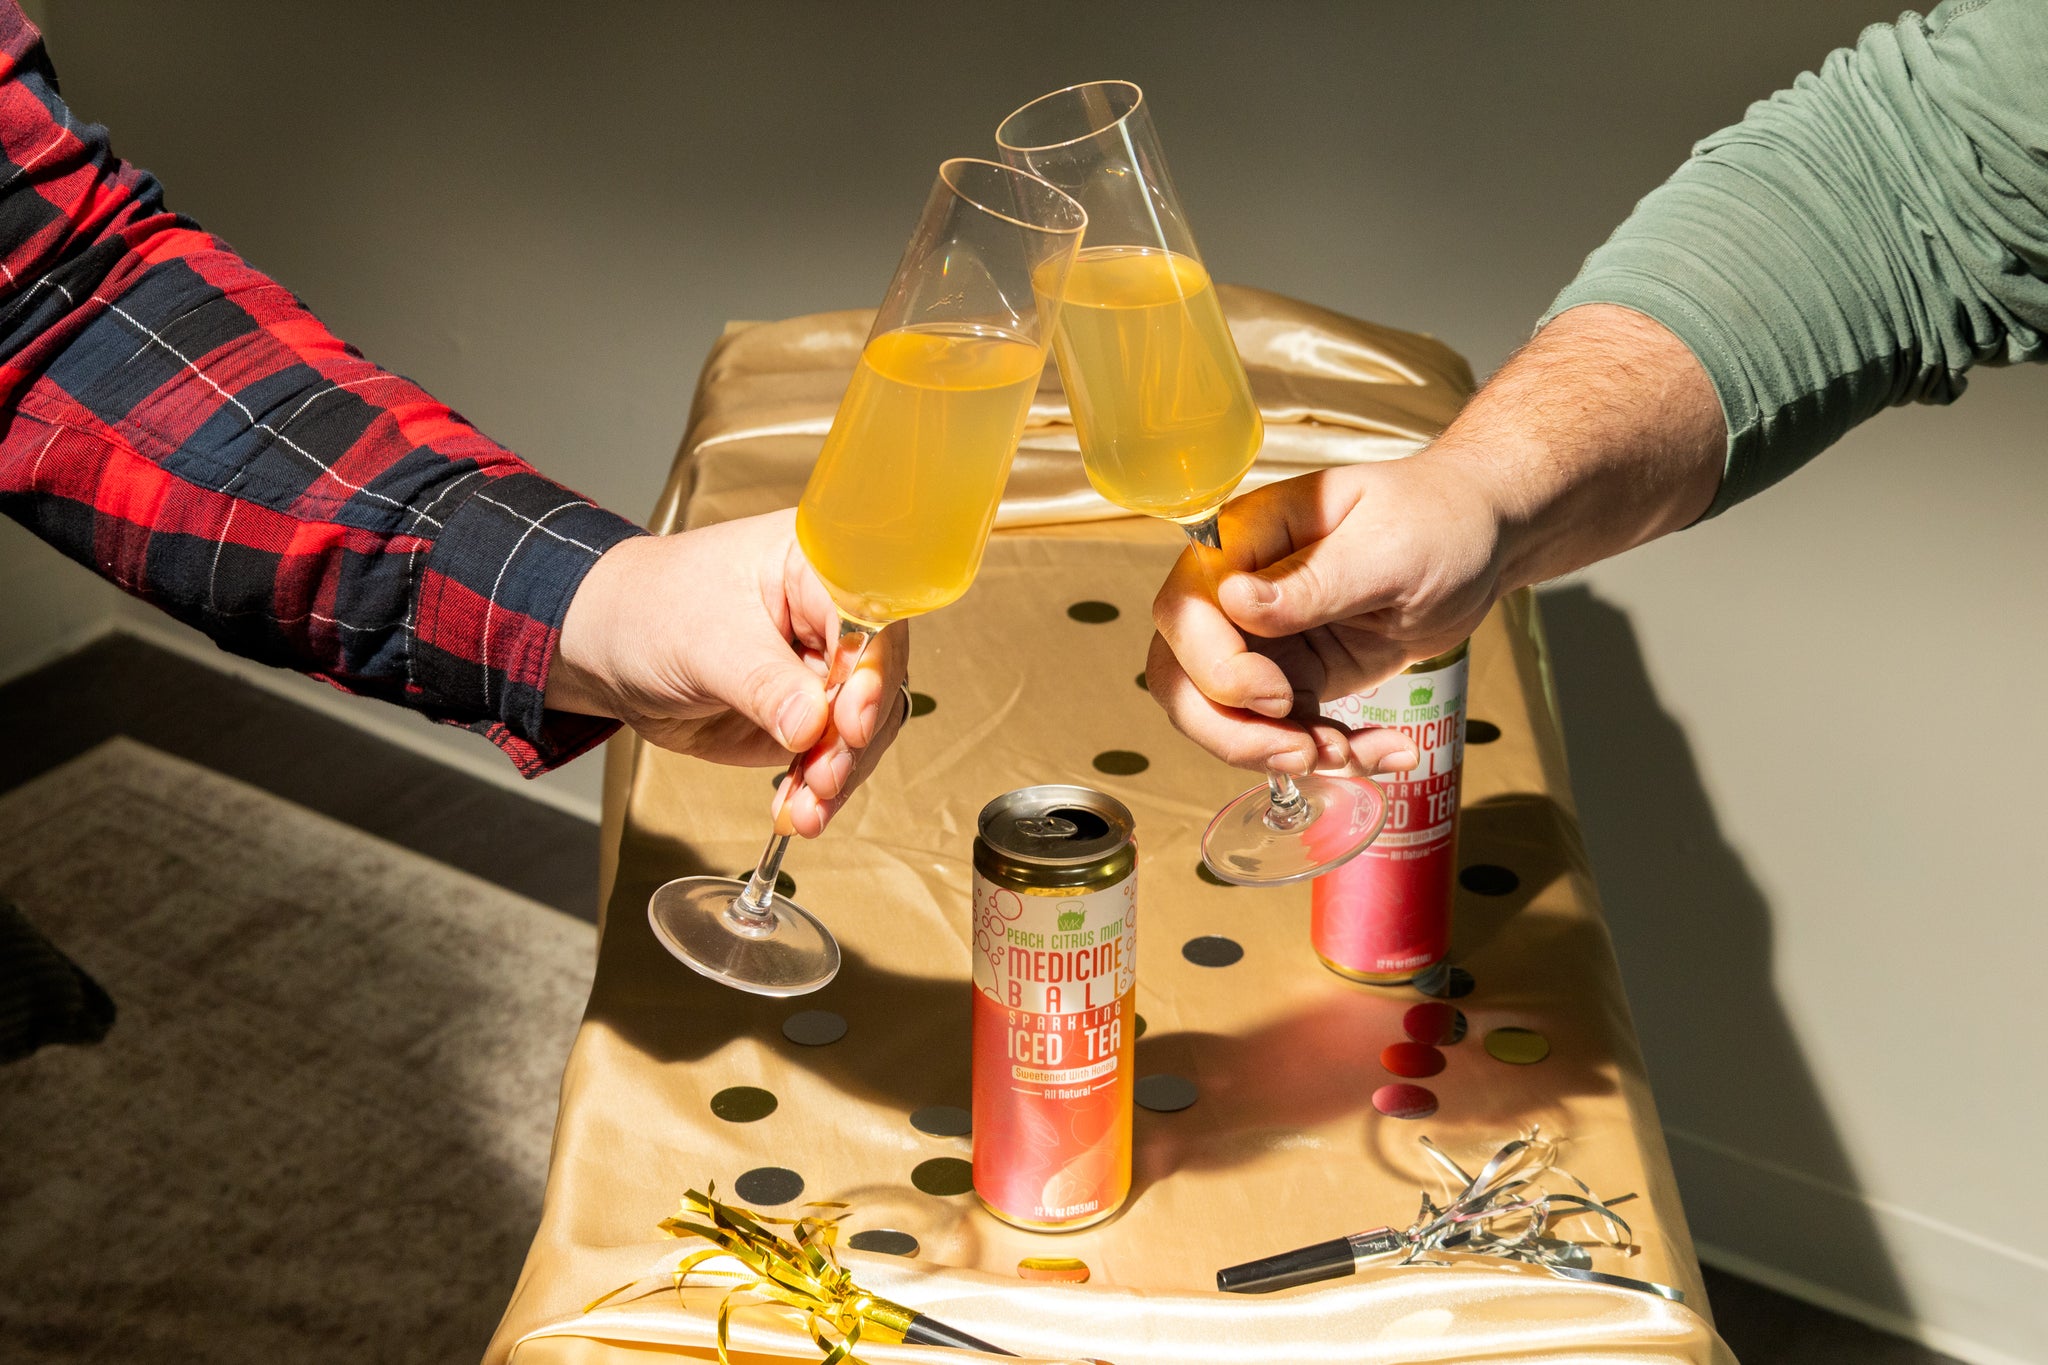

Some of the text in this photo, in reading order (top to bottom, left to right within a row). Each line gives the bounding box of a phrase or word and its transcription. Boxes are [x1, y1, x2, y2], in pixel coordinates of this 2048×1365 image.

[1362, 705, 1397, 723] PEACH
[1403, 704, 1440, 723] CITRUS
[1363, 710, 1460, 751] ICINE
[1386, 769, 1456, 798] ARKLING
[1427, 785, 1455, 824] TEA
[1007, 918, 1123, 949] PEACH CITRUS MINT
[1059, 919, 1080, 930] WK
[1008, 936, 1122, 983] MEDICINE
[1008, 1001, 1121, 1031] SPARKLING
[1008, 1018, 1121, 1066] ICED TEA
[1015, 1060, 1114, 1082] Sweetened With Honey
[1044, 1085, 1091, 1099] All Natural
[1034, 1206, 1043, 1217] 12
